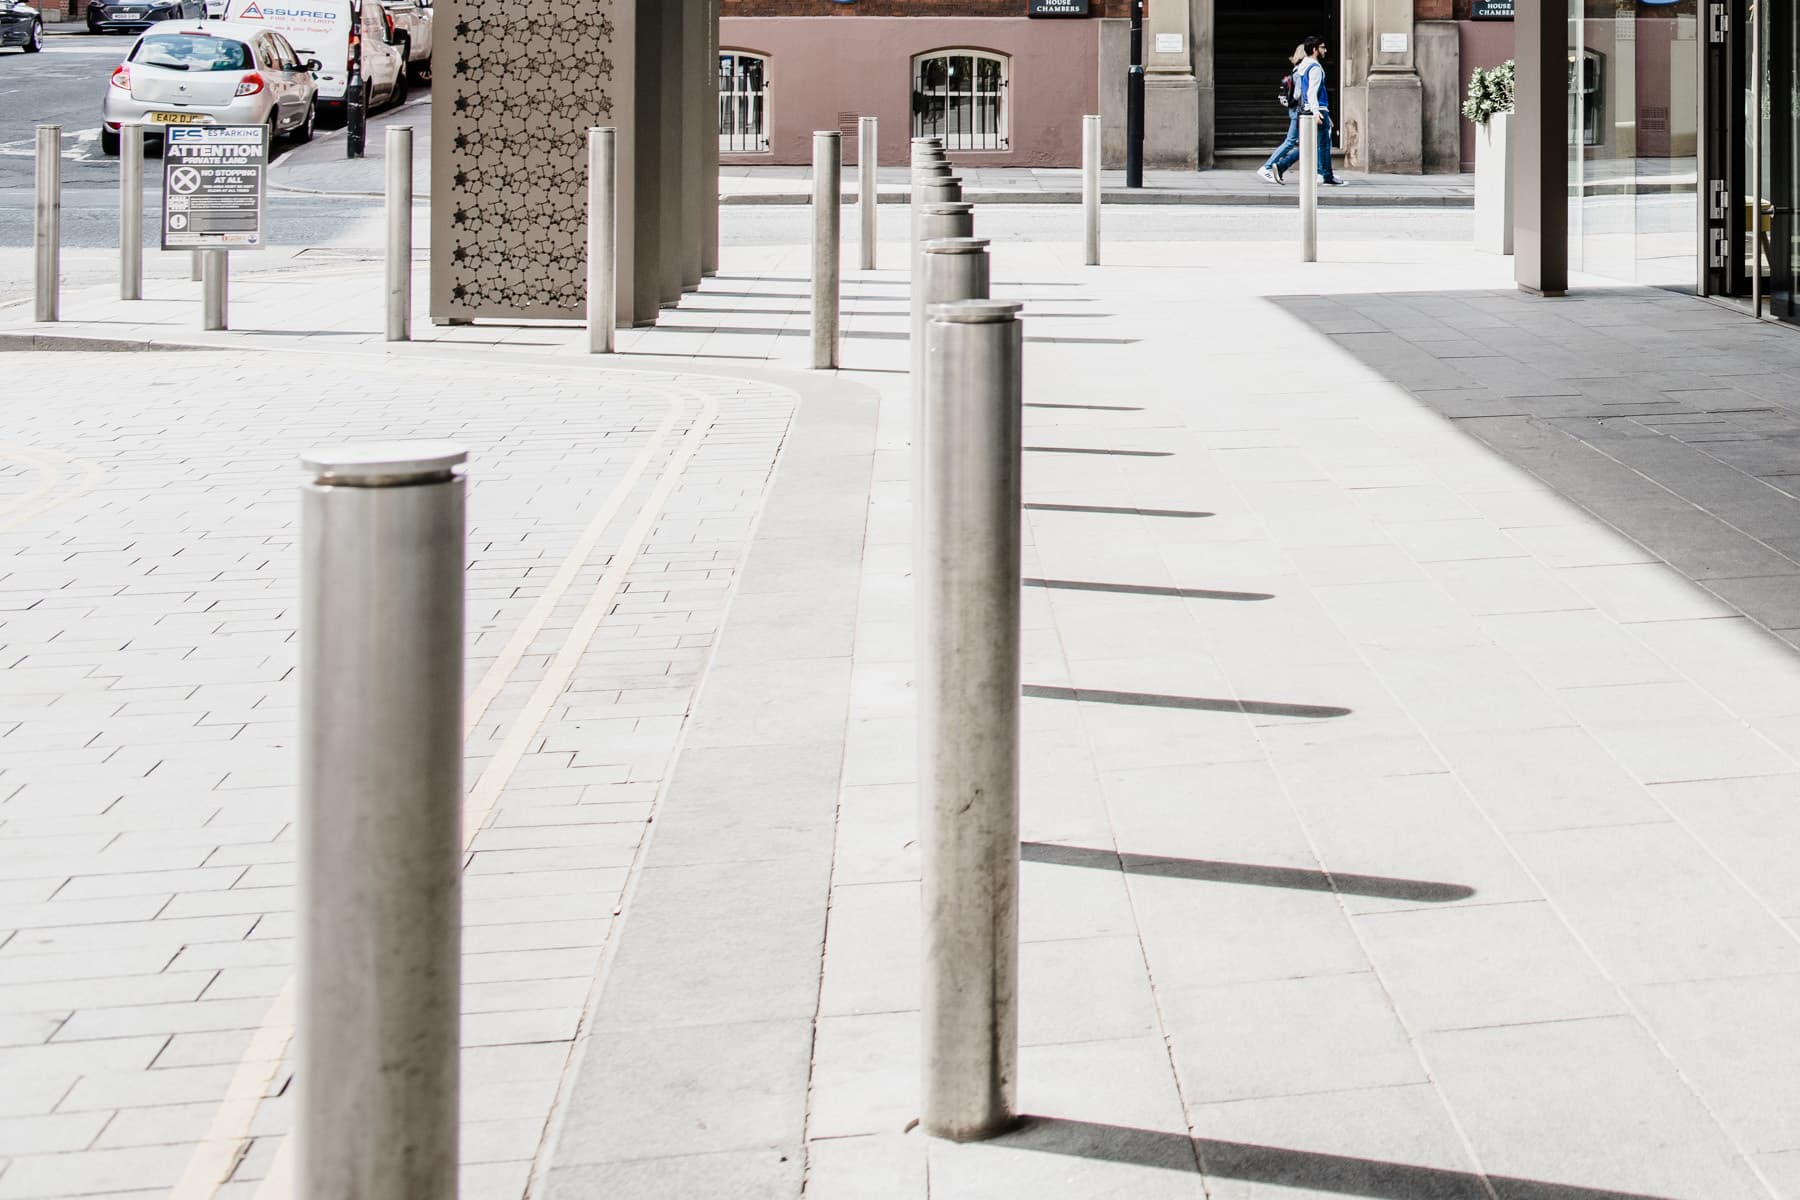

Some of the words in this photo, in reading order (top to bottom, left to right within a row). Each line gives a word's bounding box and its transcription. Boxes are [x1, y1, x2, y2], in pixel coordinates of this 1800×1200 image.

[246, 6, 336, 19] ASSURED
[156, 113, 177, 122] EA12
[168, 145, 263, 157] ATTENTION
[200, 169, 214, 177] NO
[215, 169, 257, 177] STOPPING
[214, 176, 226, 184] AT
[227, 176, 243, 184] ALL
